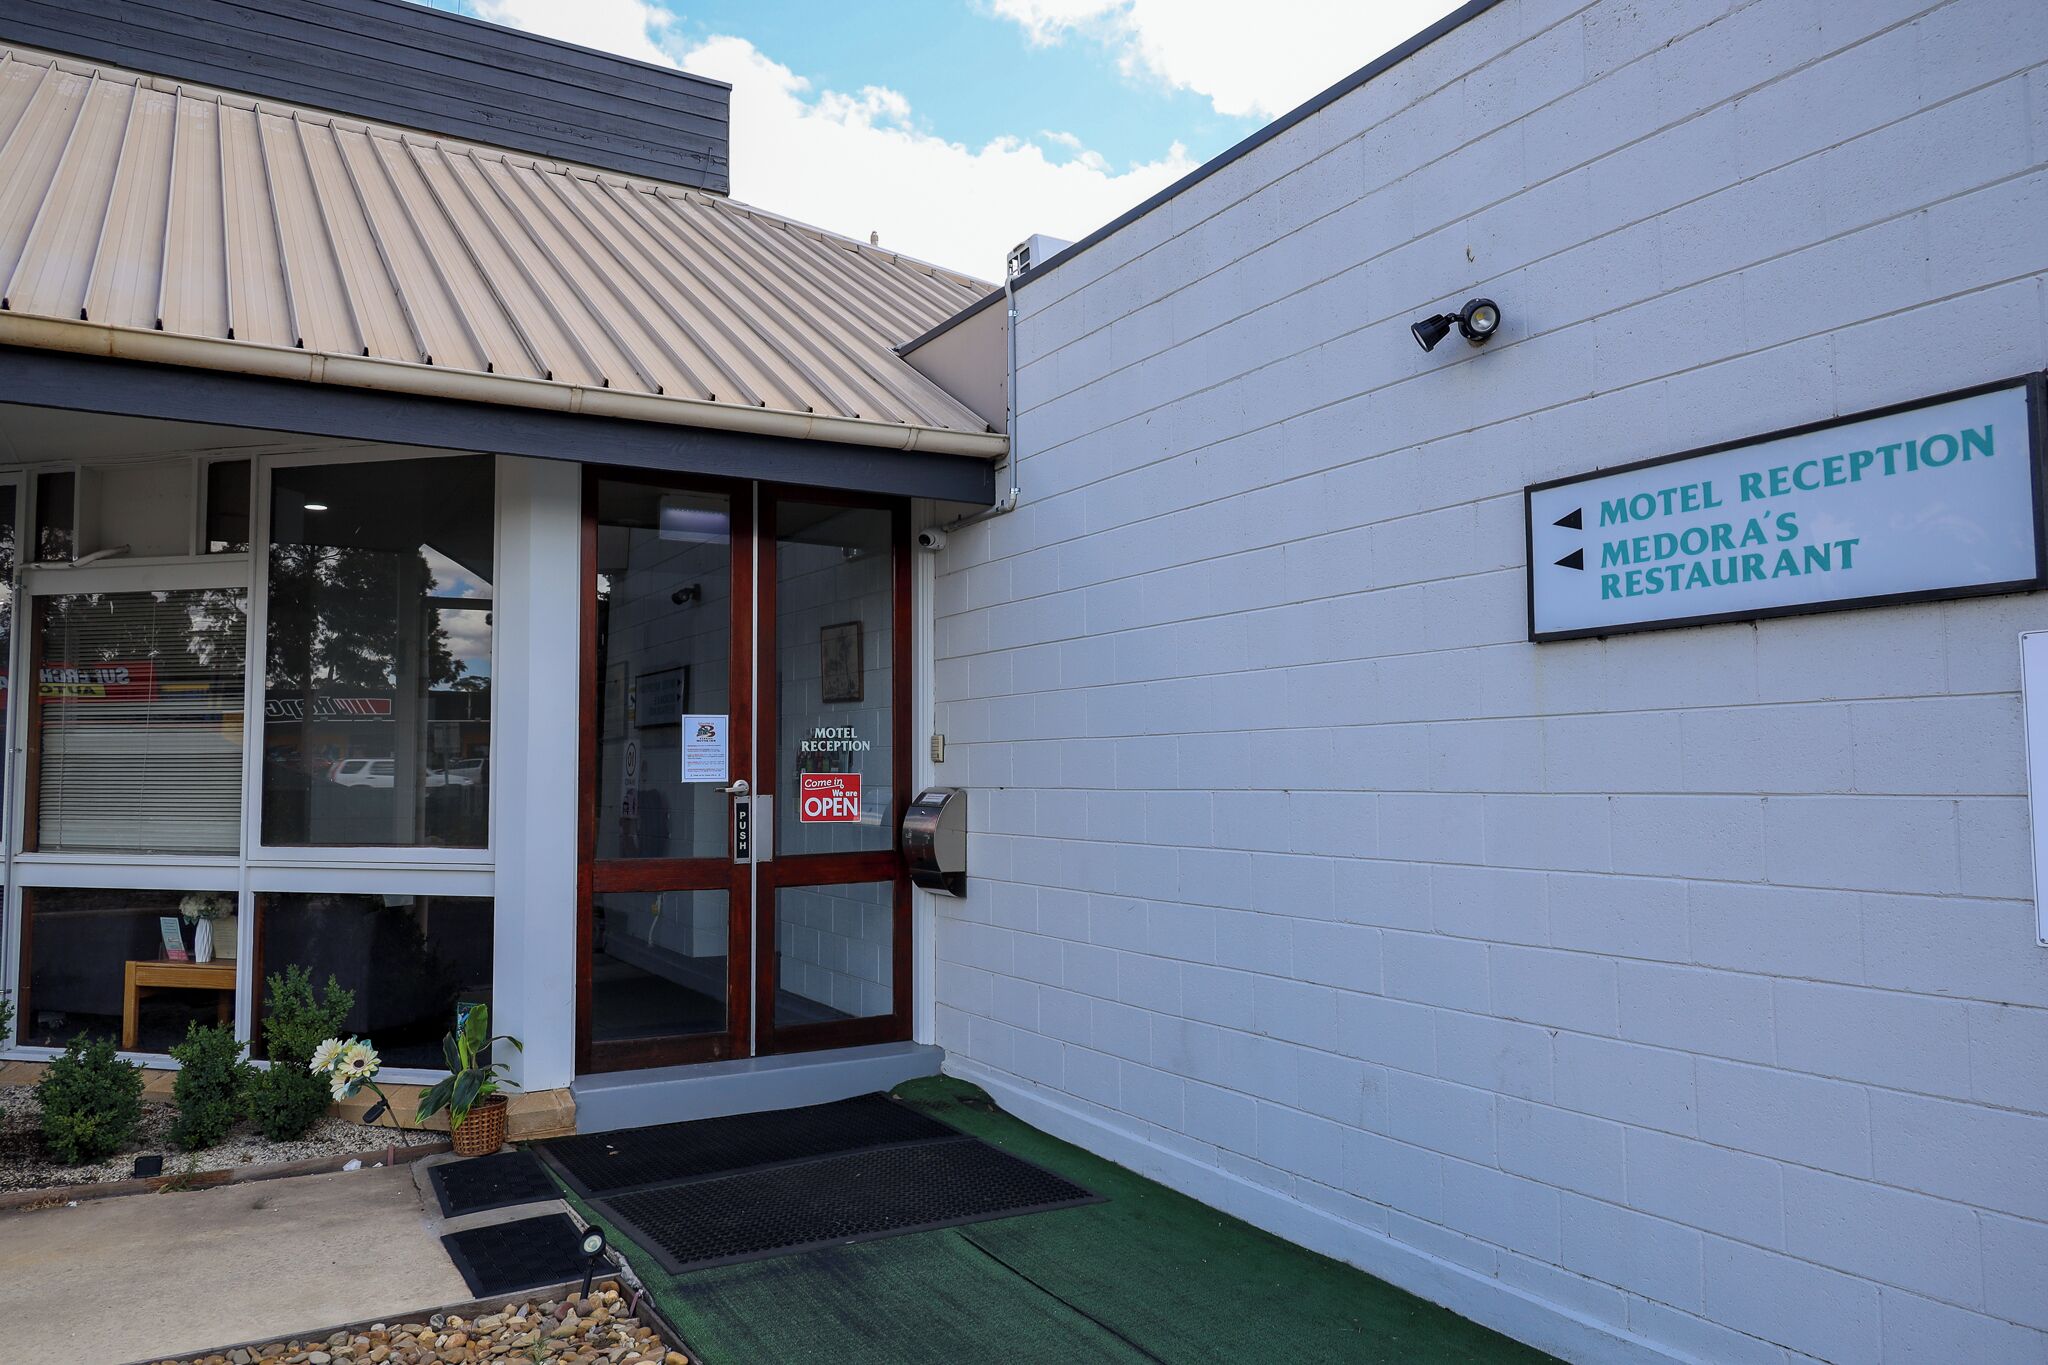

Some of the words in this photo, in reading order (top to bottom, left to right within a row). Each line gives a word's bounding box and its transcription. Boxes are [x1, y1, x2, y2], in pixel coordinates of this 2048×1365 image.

[1599, 480, 1722, 527] MOTEL
[1739, 424, 1996, 503] RECEPTION
[1600, 509, 1799, 569] MEDORA'S
[1600, 538, 1860, 601] RESTAURANT
[814, 727, 858, 739] MOTEL
[801, 740, 871, 752] RECEPTION
[804, 778, 832, 788] Come
[833, 776, 845, 789] in
[832, 789, 843, 797] We
[804, 797, 858, 817] OPEN
[739, 811, 747, 850] PUSH
